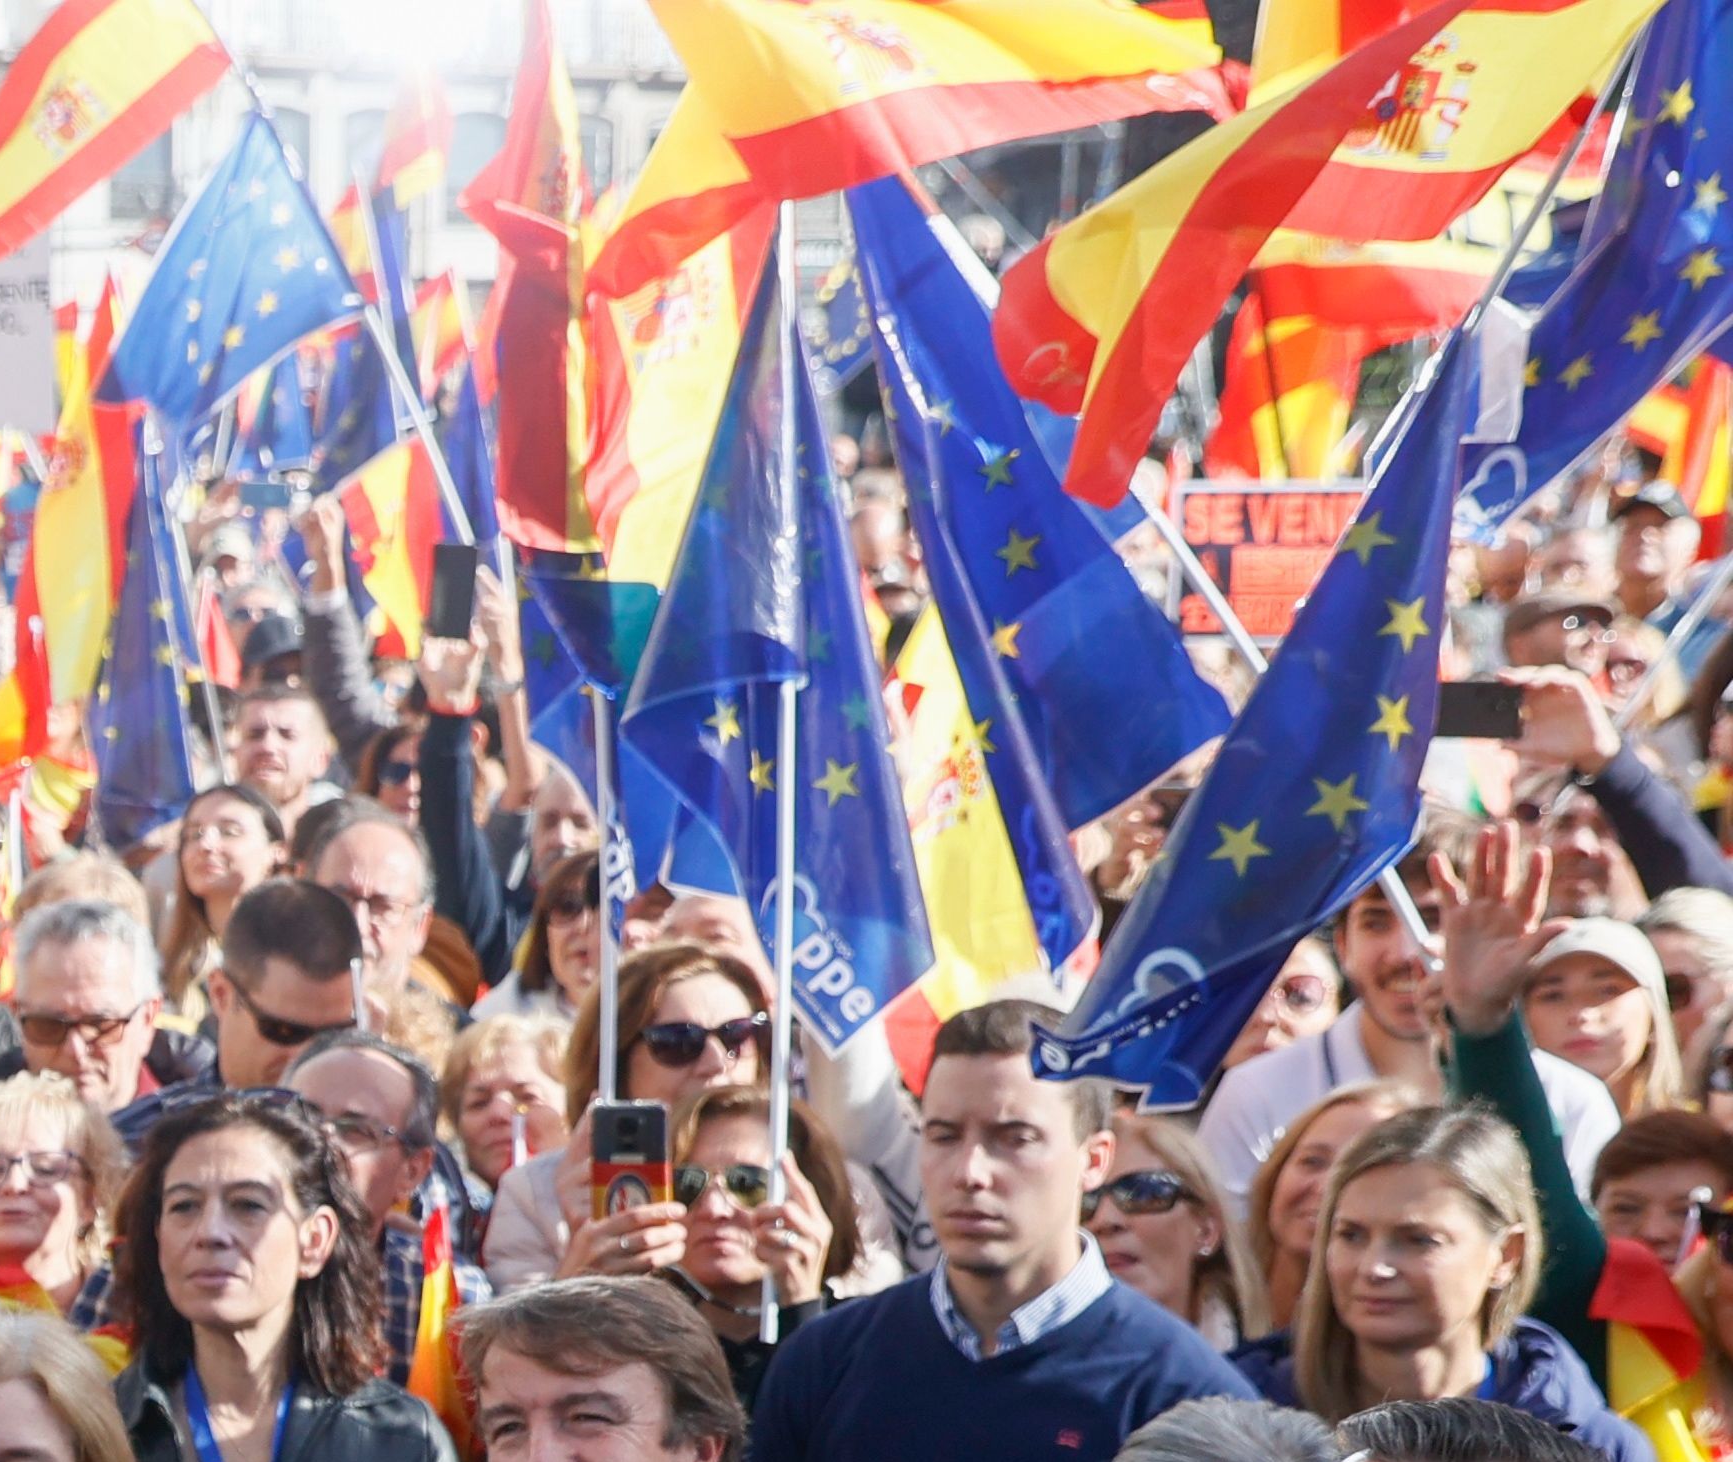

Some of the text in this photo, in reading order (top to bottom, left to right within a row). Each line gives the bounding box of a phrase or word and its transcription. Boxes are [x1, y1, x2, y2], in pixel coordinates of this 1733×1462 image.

[1184, 493, 1362, 545] SE VEN
[792, 932, 876, 1024] ppe
